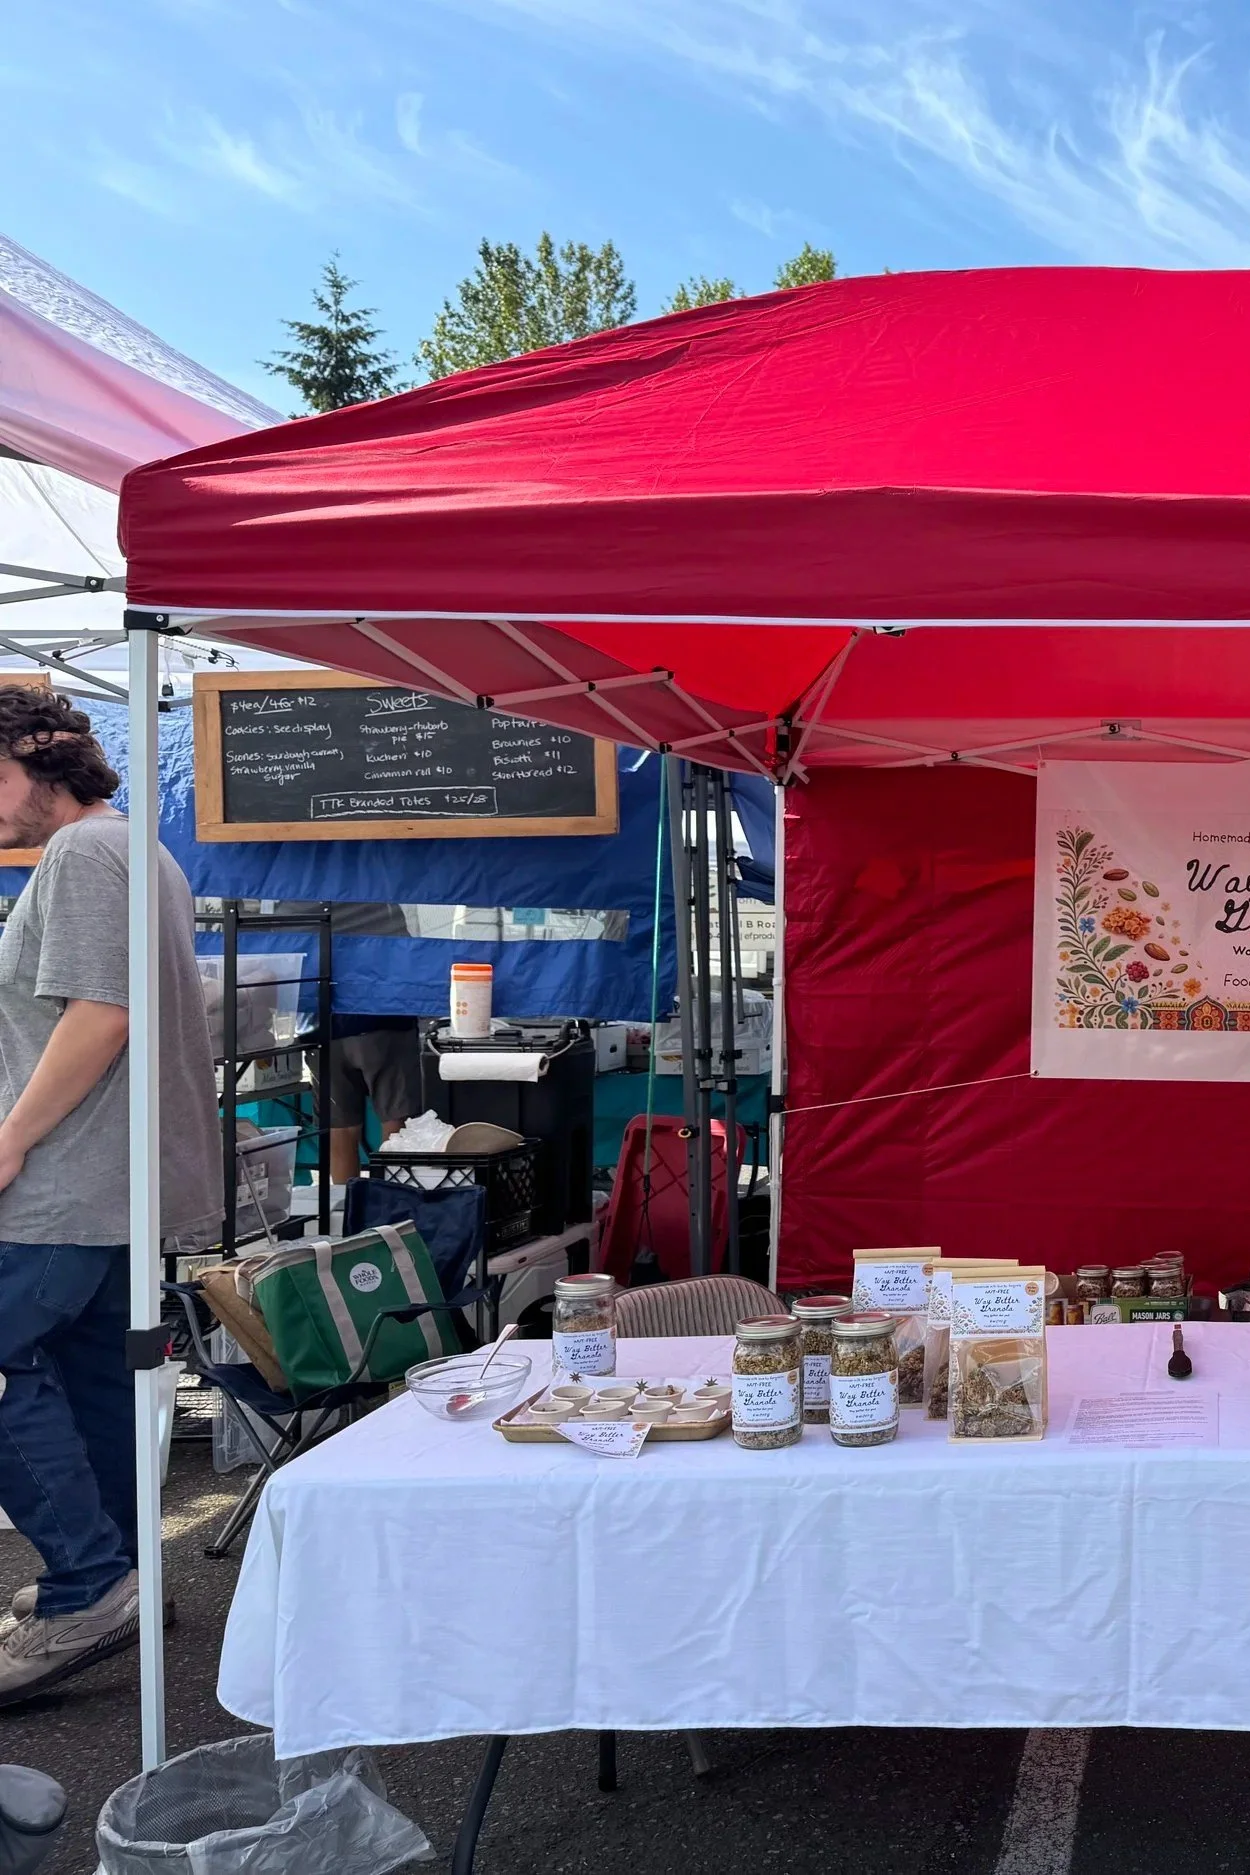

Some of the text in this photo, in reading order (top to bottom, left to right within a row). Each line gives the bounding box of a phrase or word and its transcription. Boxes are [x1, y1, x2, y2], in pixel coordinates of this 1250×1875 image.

[366, 691, 430, 714] Sweets
[225, 725, 271, 735] Cookies:
[492, 737, 541, 749] Brownies
[226, 751, 264, 763] Scones:
[285, 762, 316, 771] vanilla
[364, 769, 412, 780] Cinnamon
[350, 796, 394, 808] Branded
[399, 797, 431, 807] Totes
[995, 1296, 1020, 1304] Better
[1093, 1312, 1171, 1324] Ball MASON JARS
[738, 1388, 783, 1398] Way Better
[839, 1388, 886, 1401] Way Better
